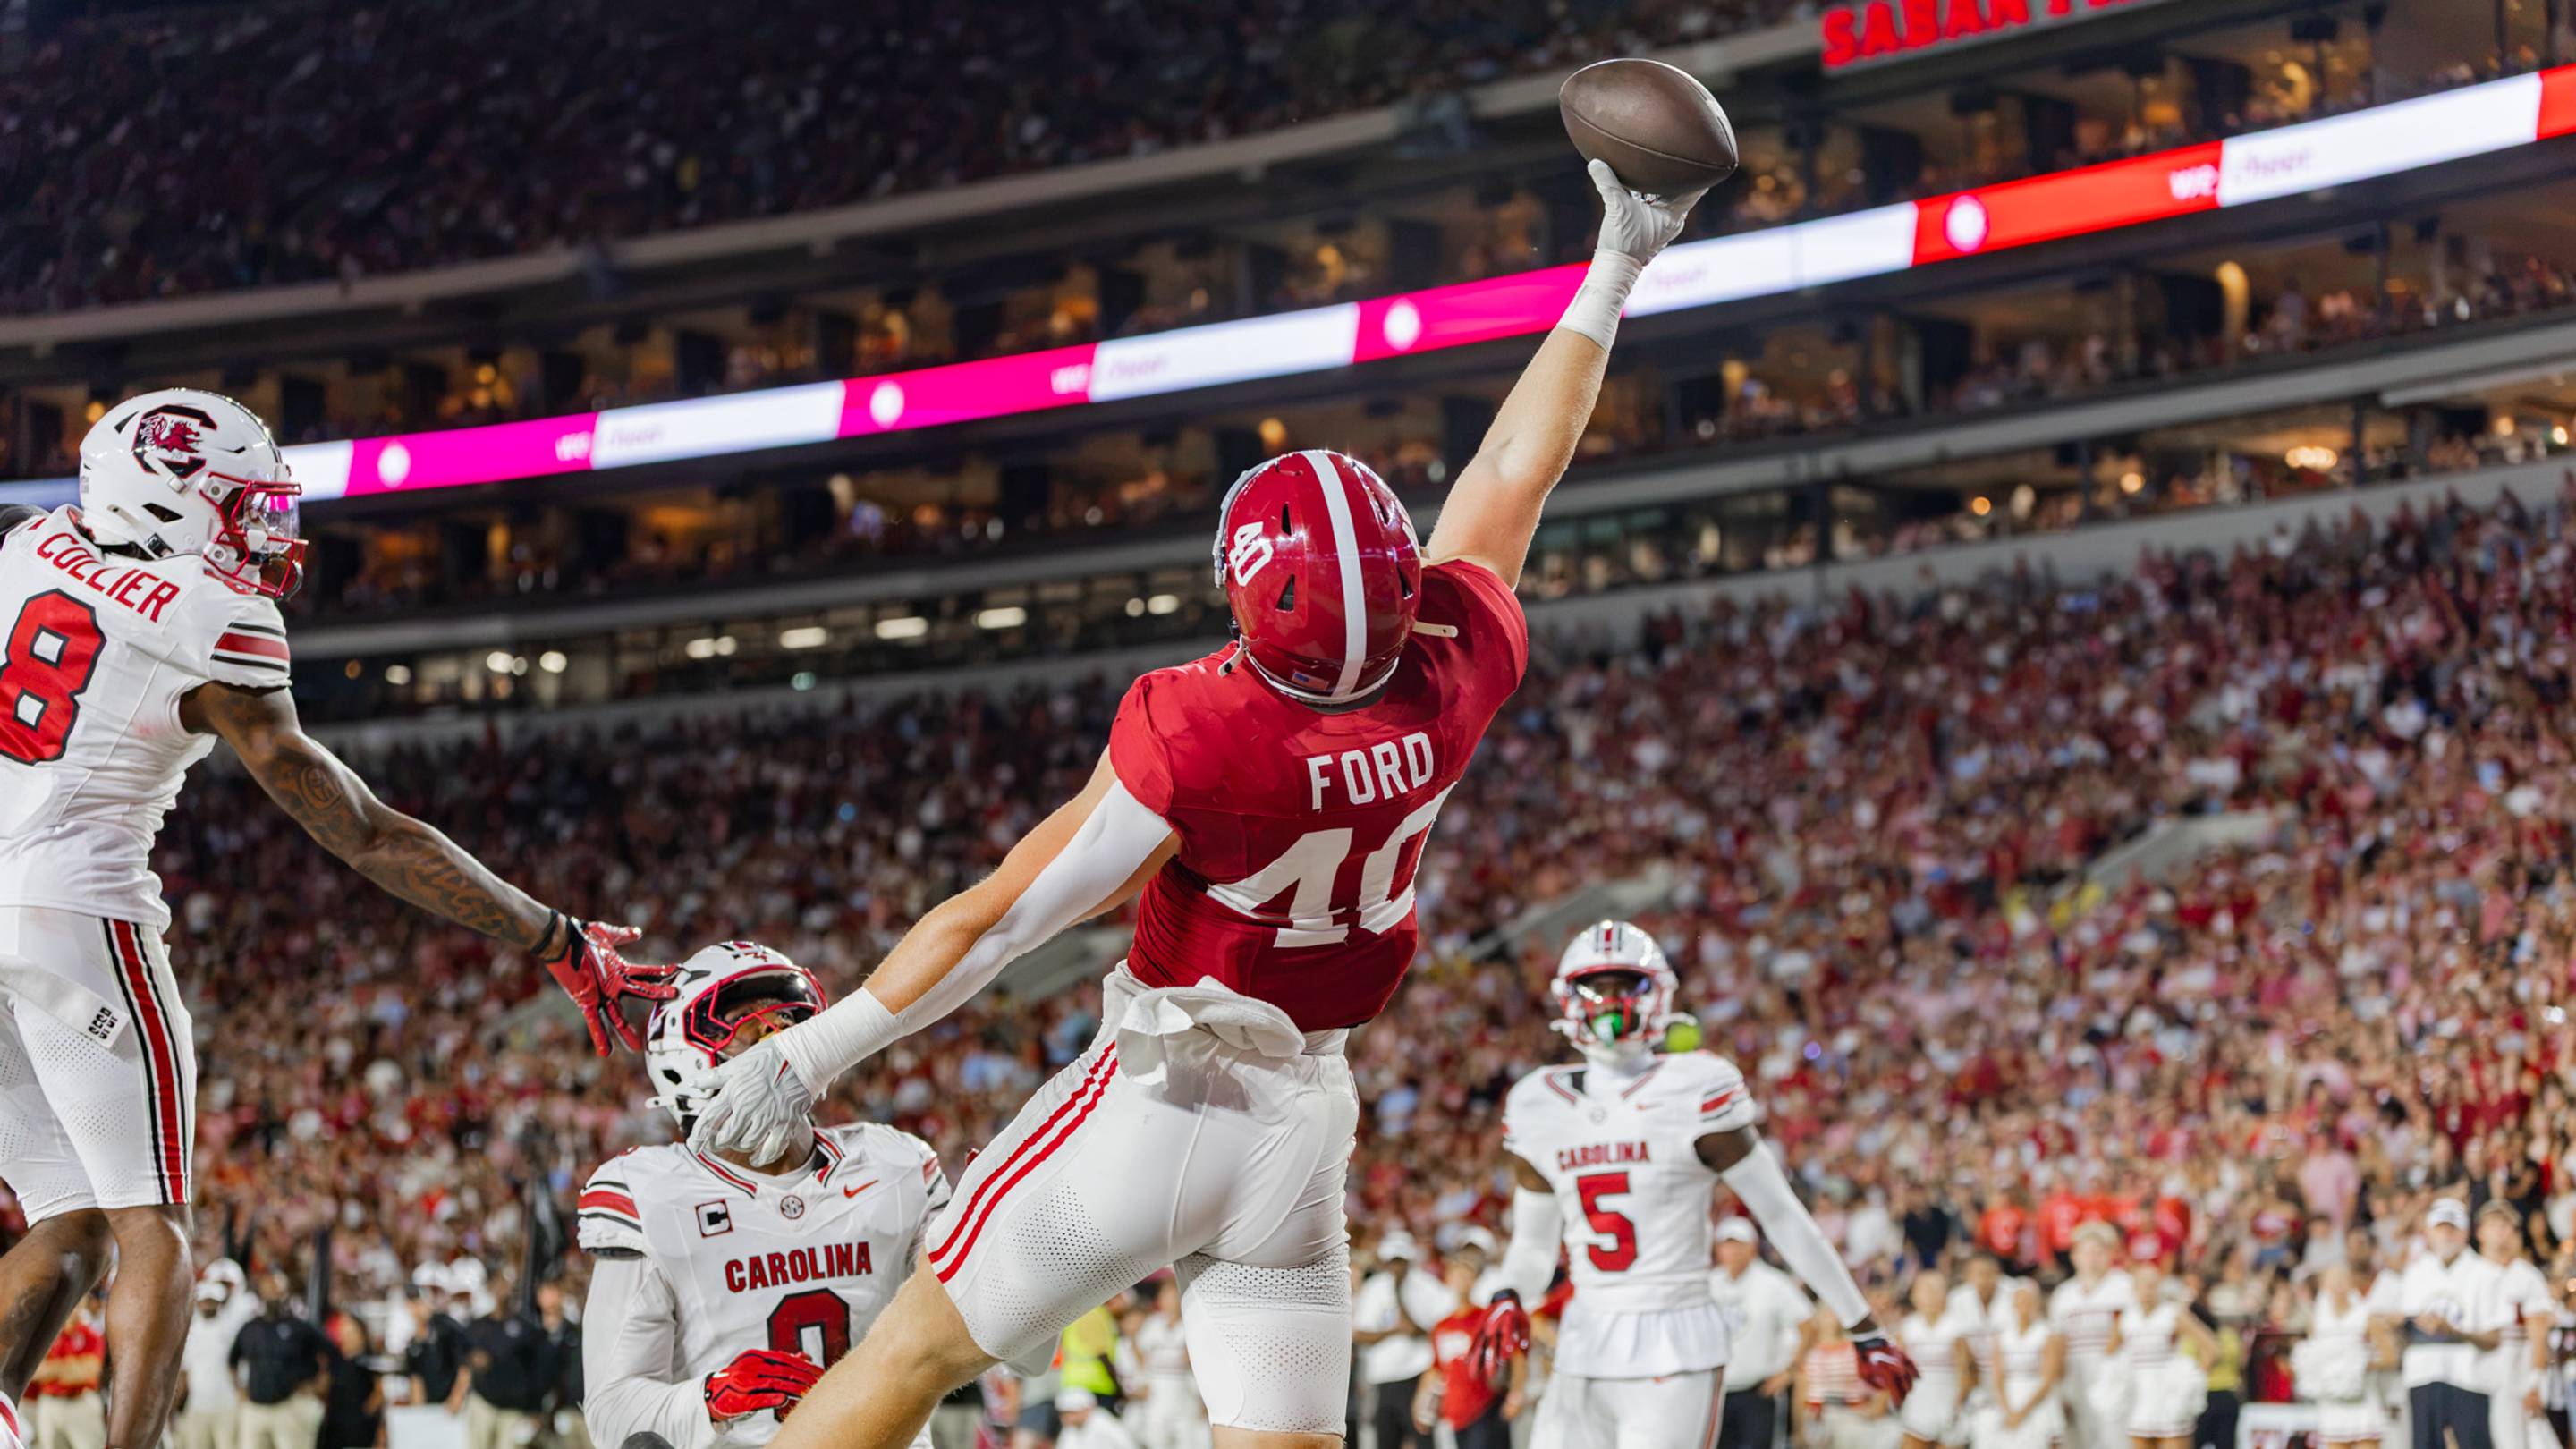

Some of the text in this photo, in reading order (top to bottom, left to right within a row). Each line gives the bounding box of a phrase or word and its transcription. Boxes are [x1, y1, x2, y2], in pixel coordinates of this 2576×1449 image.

[36, 532, 182, 623] COLLIER
[1228, 521, 1274, 587] 40
[0, 588, 107, 767] 8
[1306, 732, 1434, 810] FORD
[1206, 781, 1458, 948] 40
[1556, 1140, 1650, 1172] CAROLINA
[1576, 1171, 1638, 1272] 5
[724, 1241, 873, 1293] CAROLINA
